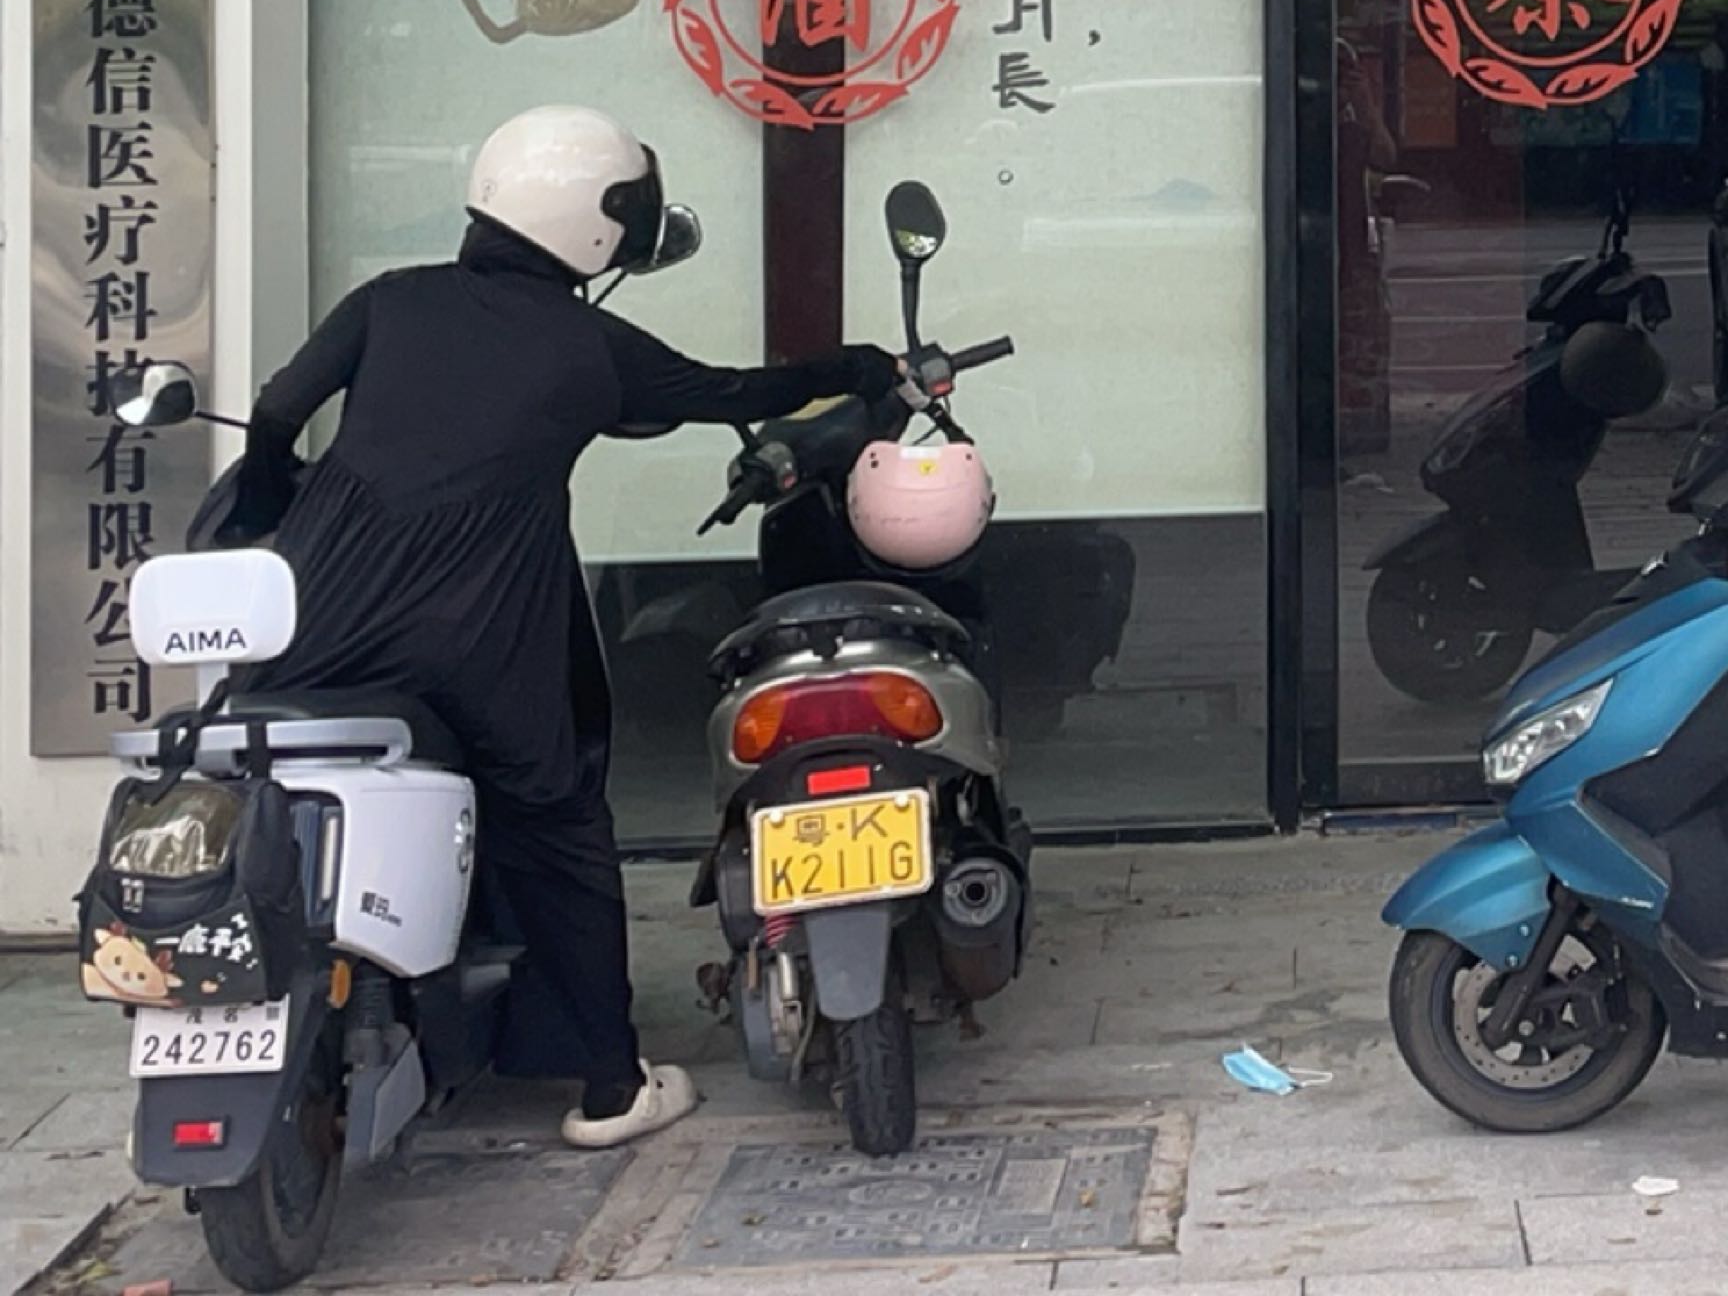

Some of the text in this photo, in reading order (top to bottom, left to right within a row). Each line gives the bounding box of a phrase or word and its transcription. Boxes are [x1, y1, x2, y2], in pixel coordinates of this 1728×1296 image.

[165, 627, 247, 655] AIMA
[771, 840, 913, 900] K211G
[141, 1029, 276, 1067] 242762
